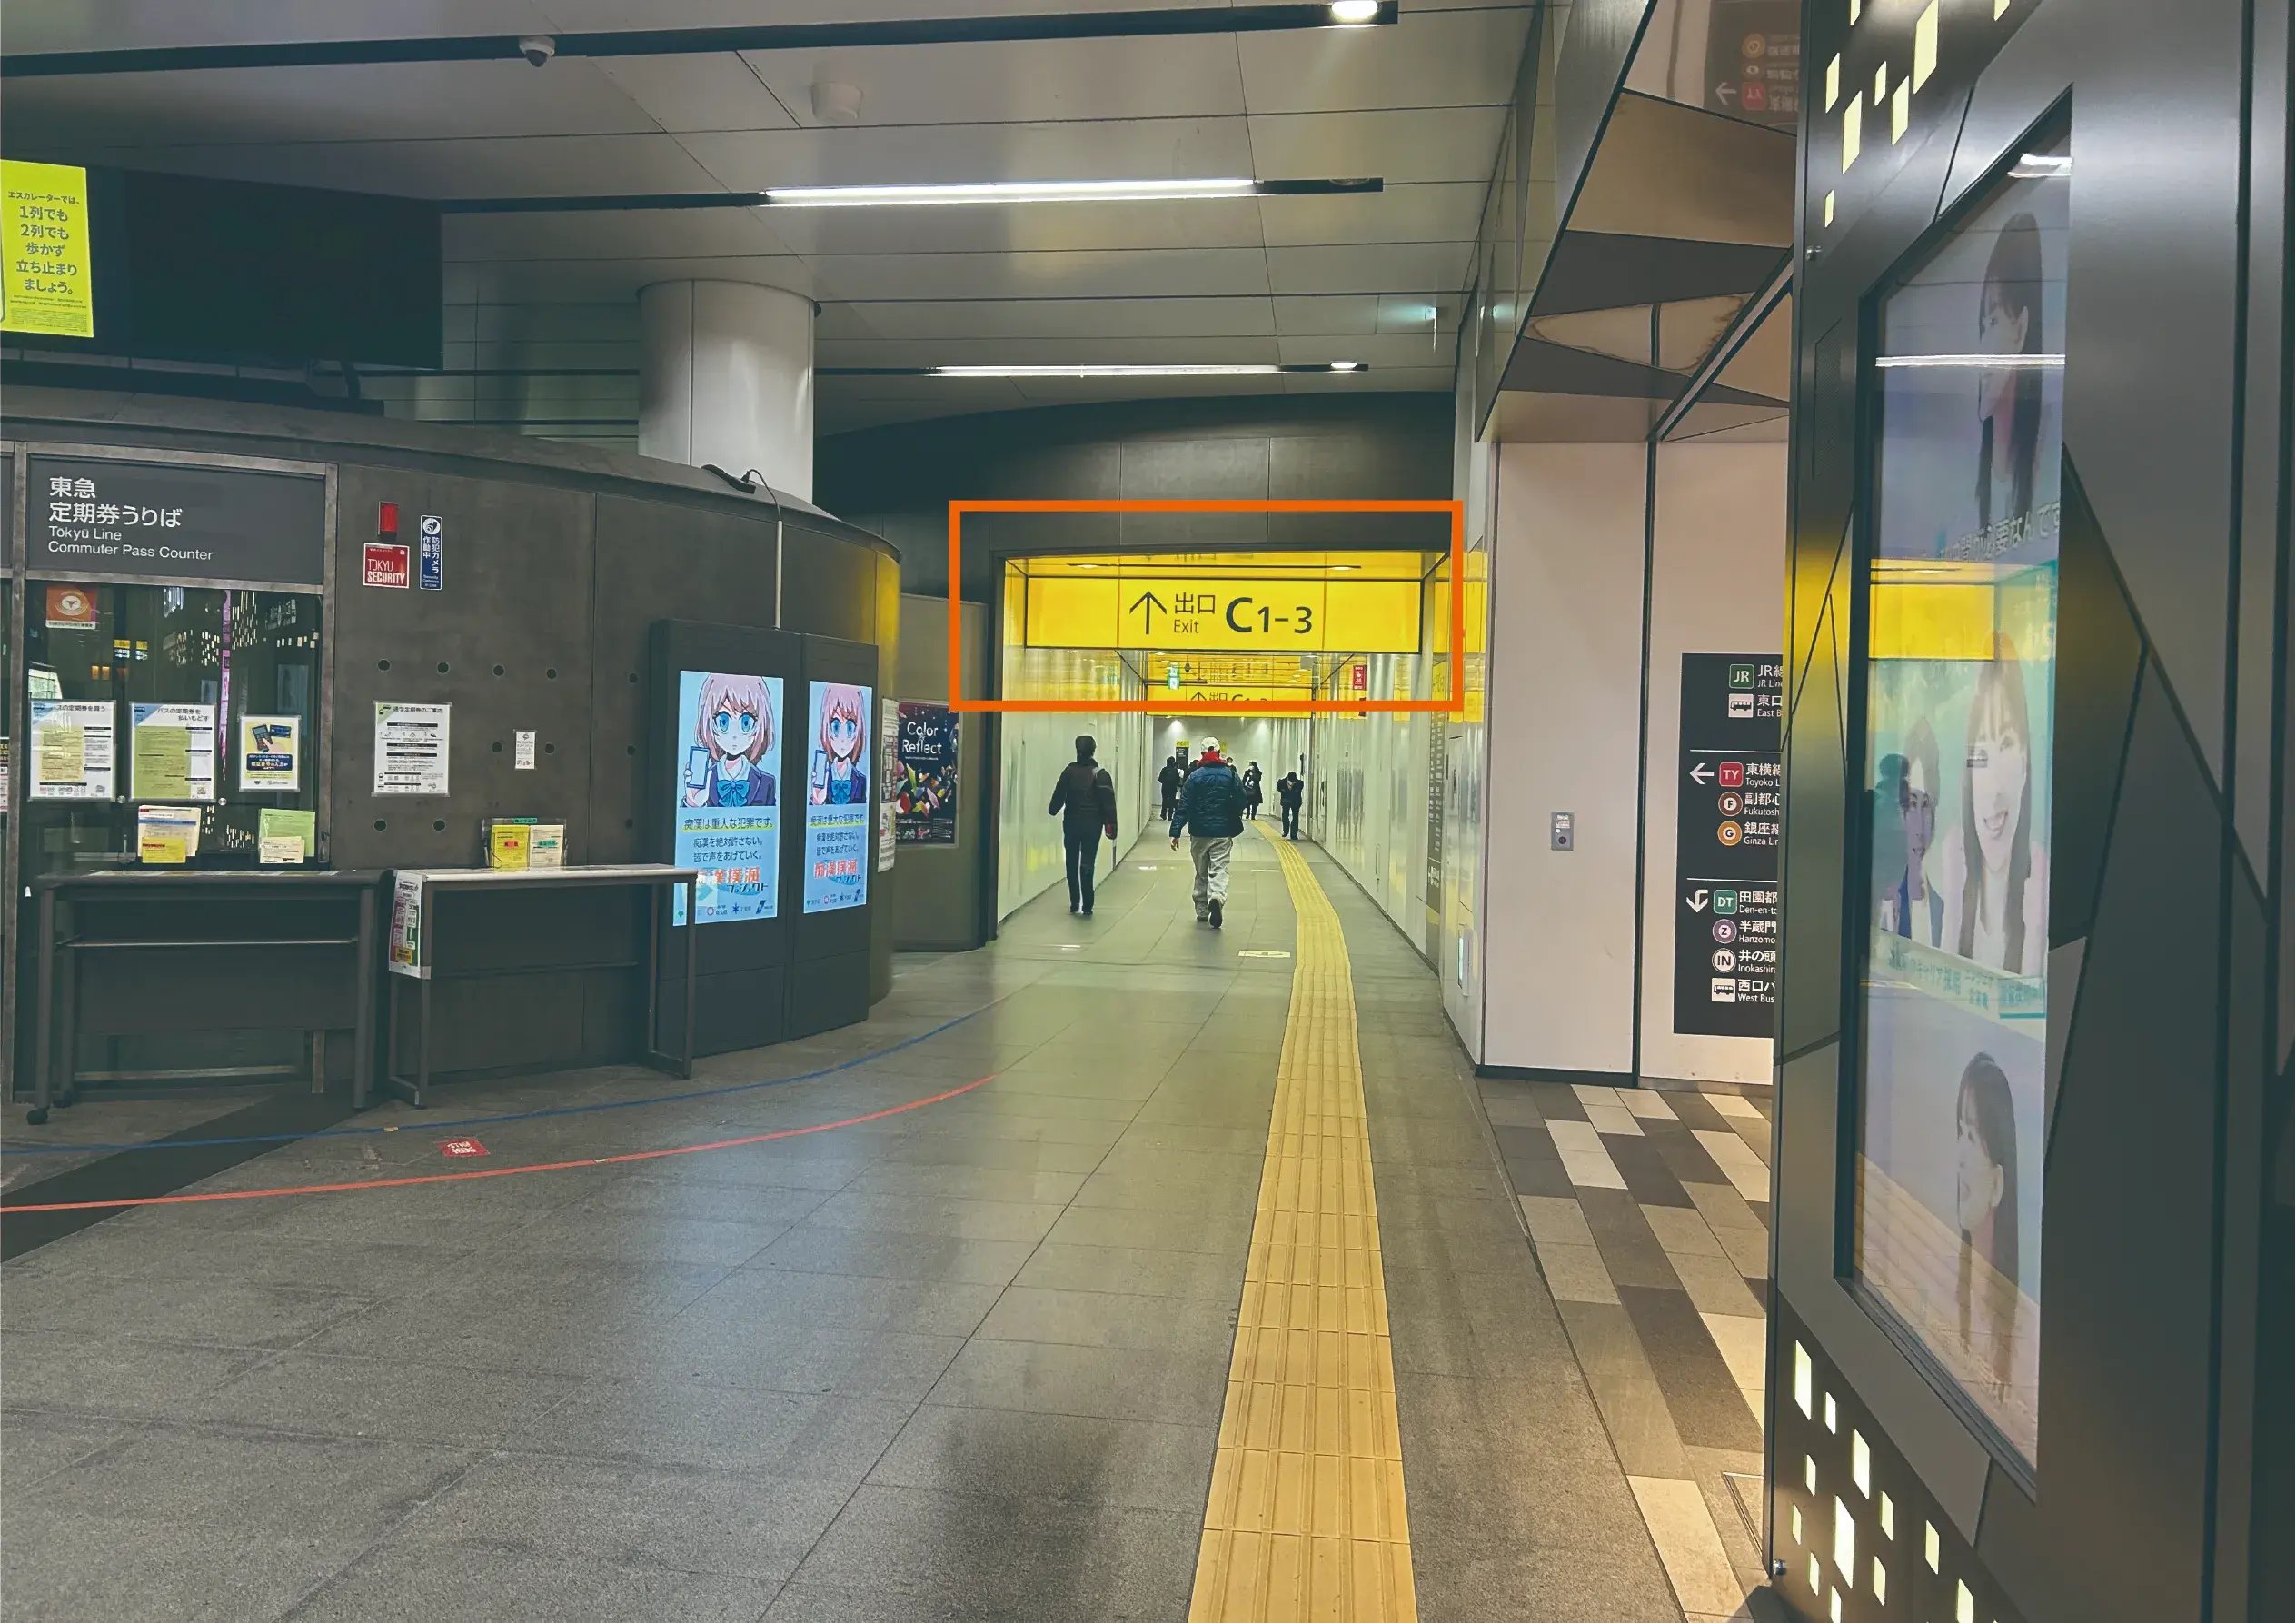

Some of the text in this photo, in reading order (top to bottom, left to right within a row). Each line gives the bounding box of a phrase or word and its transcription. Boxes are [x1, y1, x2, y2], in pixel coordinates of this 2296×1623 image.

[8, 191, 80, 205] エスカレーターでは、
[19, 206, 68, 222] 1列でも
[21, 224, 69, 240] 2列でも
[26, 242, 65, 257] 歩かず
[16, 260, 77, 276] 立ち止まり
[25, 278, 73, 294] ましょう。
[49, 476, 96, 499] 東急
[48, 502, 183, 528] 定期券うりば
[94, 528, 122, 541] Line
[48, 541, 214, 560] Commuter Pass Counter
[367, 558, 393, 572] TOKYU
[367, 571, 405, 584] SECURITY
[1174, 592, 1313, 634] 出口 C1-3
[1173, 619, 1199, 633] Exit
[1734, 671, 1750, 682] JR
[1757, 679, 1766, 688] JR
[1757, 694, 1783, 706] 東口
[1757, 709, 1774, 717] East
[907, 721, 939, 737] Color
[901, 739, 942, 754] Reflect
[1723, 770, 1740, 780] TY
[1745, 777, 1774, 788] Toyoko
[1727, 800, 1734, 808] F
[1744, 792, 1780, 806] 副都心
[1744, 807, 1780, 816] Fukutosh
[1725, 829, 1734, 837] G
[1744, 836, 1766, 845] Ginza
[1717, 897, 1734, 907] DT
[1739, 891, 1778, 904] 田園都
[1721, 927, 1727, 935] Z
[1739, 920, 1777, 933] 半蔵門
[1738, 934, 1776, 943] Hanzomo
[1717, 955, 1732, 966] IN
[1738, 950, 1776, 963] 井の頭
[1737, 992, 1774, 1003] West Bus
